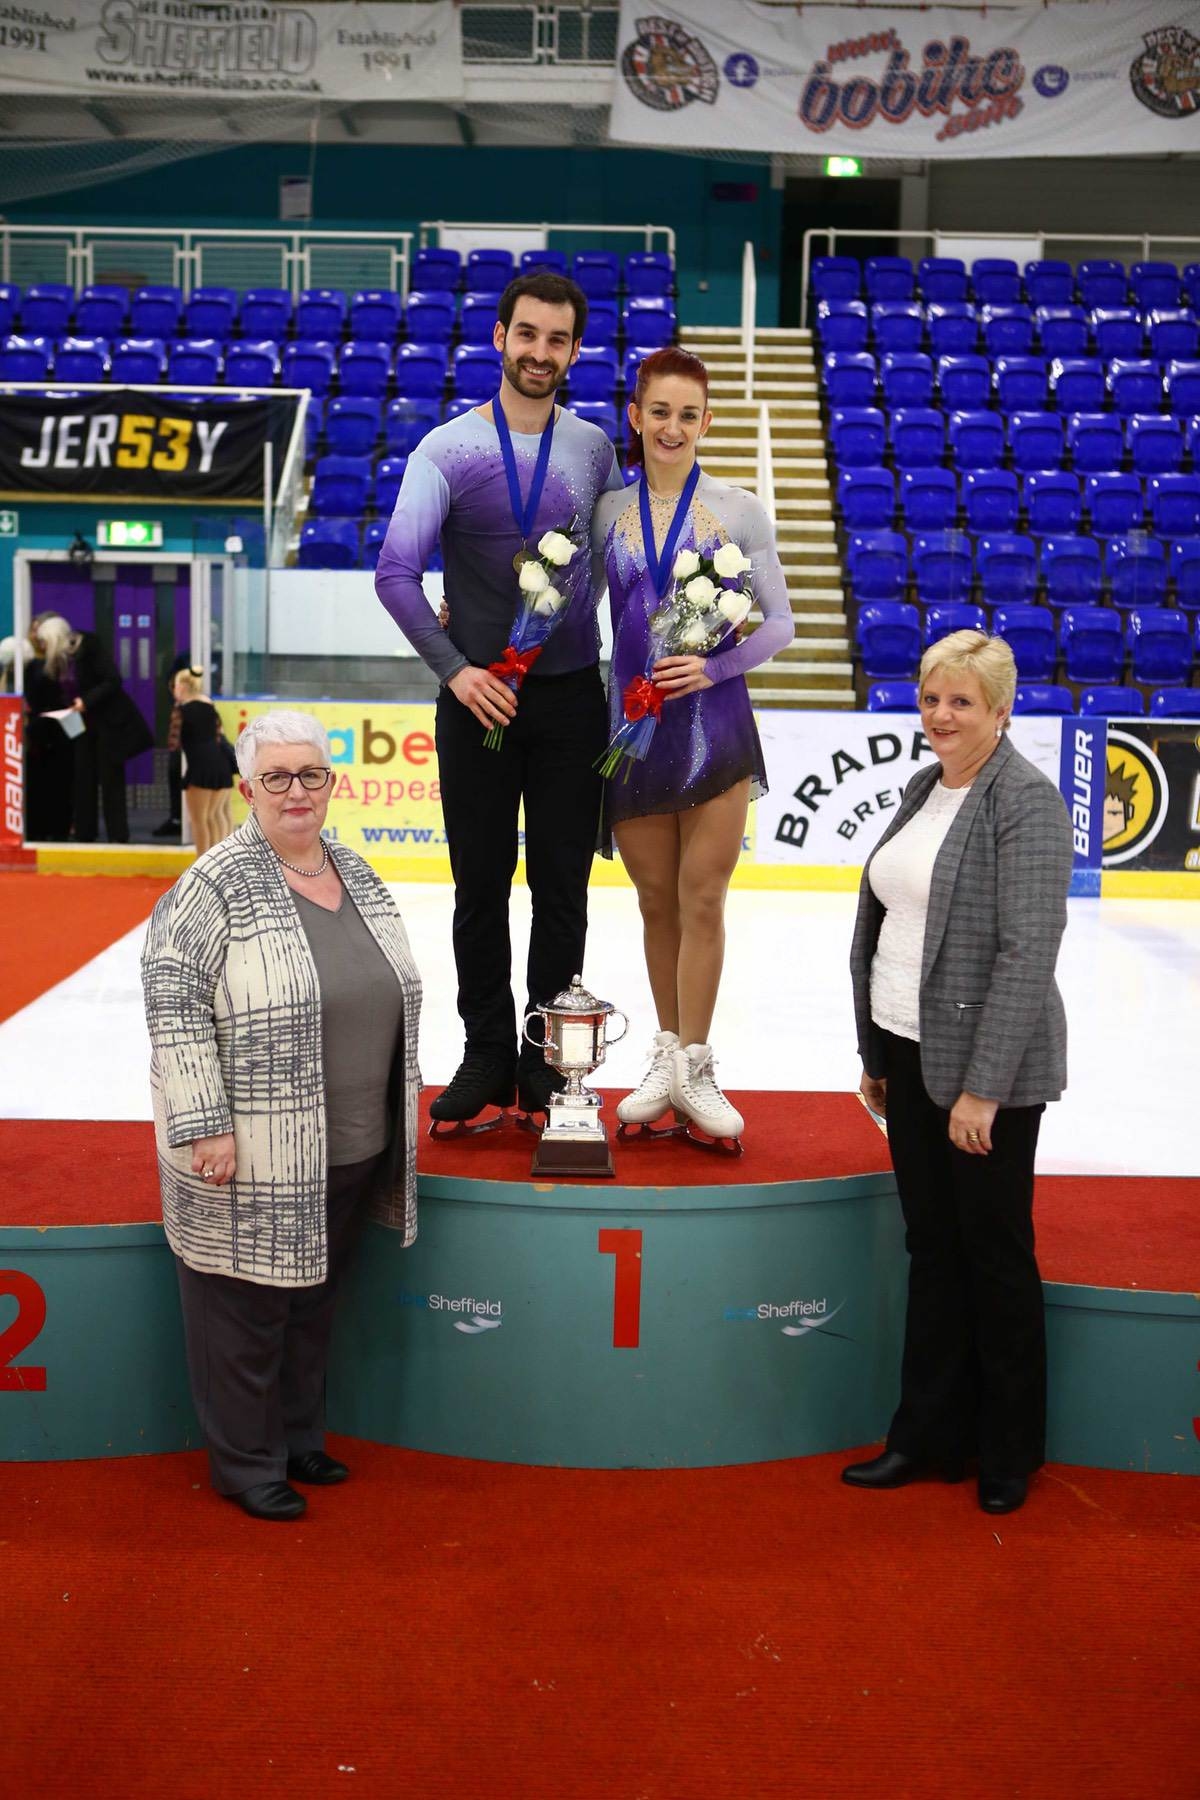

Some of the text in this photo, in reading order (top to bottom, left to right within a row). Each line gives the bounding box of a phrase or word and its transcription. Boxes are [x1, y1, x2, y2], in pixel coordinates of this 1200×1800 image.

[0, 25, 47, 51] 1991
[20, 414, 228, 472] JER53Y
[837, 786, 905, 840] BRE
[429, 1294, 501, 1316] Sheffield
[598, 1228, 642, 1348] 1
[757, 1298, 827, 1319] Sheffield
[0, 1269, 47, 1391] 2
